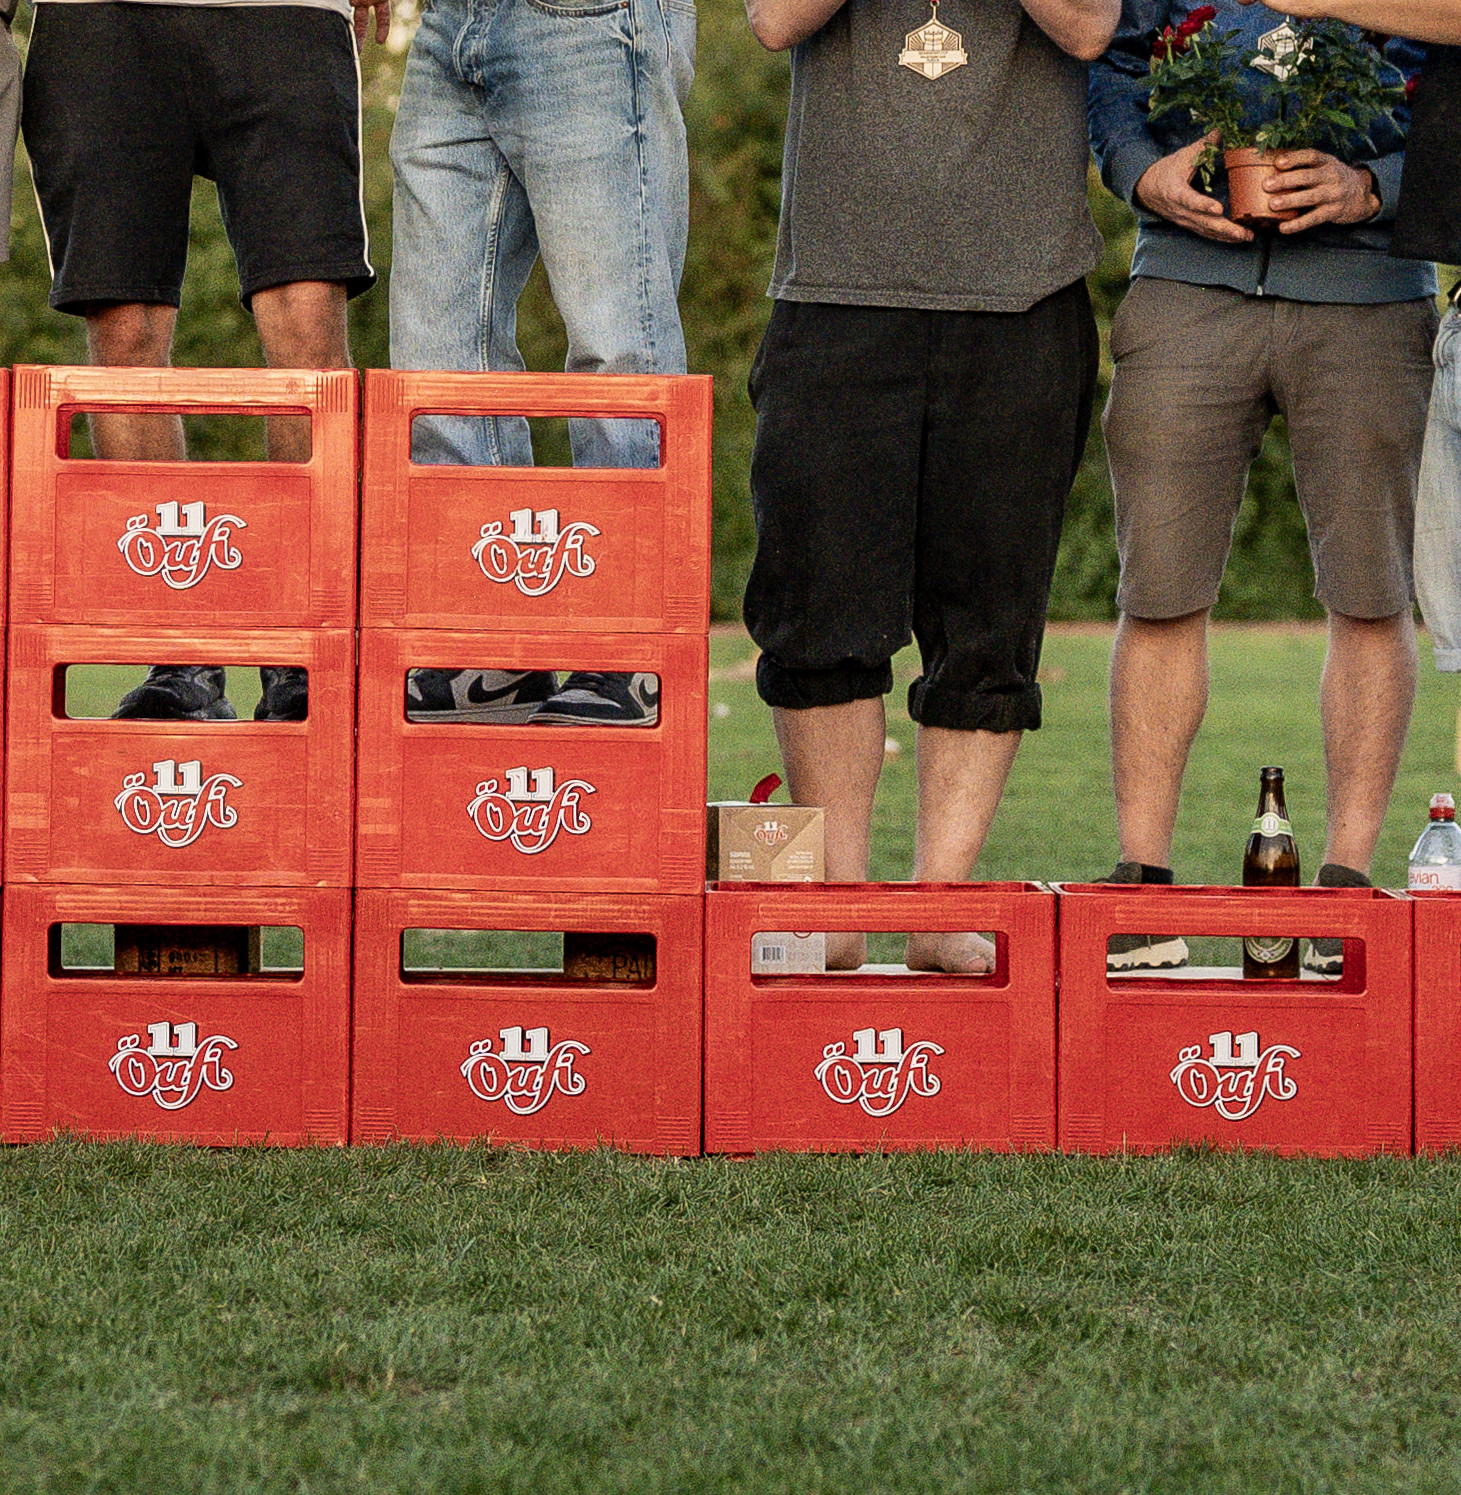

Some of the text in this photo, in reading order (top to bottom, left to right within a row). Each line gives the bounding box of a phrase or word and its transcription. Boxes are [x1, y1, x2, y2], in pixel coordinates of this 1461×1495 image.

[155, 500, 205, 536] 11
[509, 508, 559, 544] 11
[117, 514, 247, 589] Öufi
[471, 522, 601, 595] Öufi
[151, 759, 201, 795] 11
[504, 766, 554, 802] 11
[113, 773, 243, 847] Öufi
[466, 780, 596, 853] Öufi
[1409, 871, 1439, 884] evian
[146, 1021, 196, 1057] 11
[499, 1026, 548, 1063] 11
[853, 1027, 902, 1064] 11
[1208, 1031, 1258, 1068] 11
[108, 1035, 238, 1109] Öufi
[460, 1040, 591, 1114] Öufi
[814, 1041, 945, 1116] Öufi
[1169, 1045, 1301, 1119] Öufi
